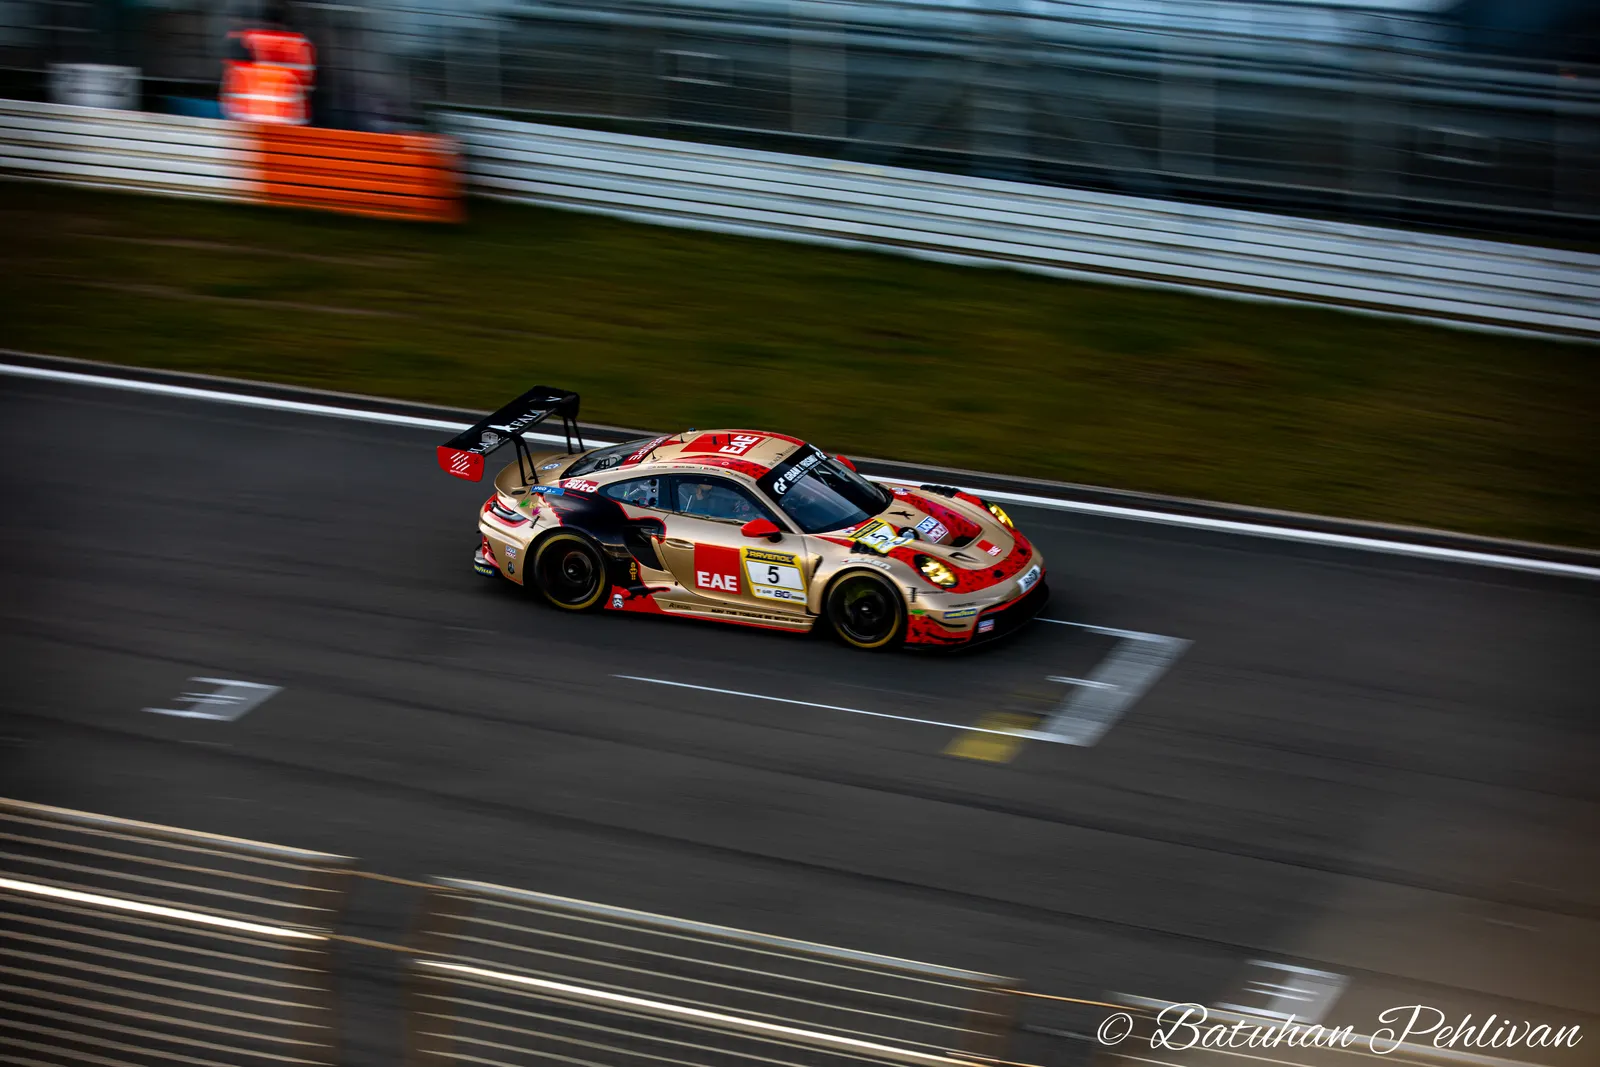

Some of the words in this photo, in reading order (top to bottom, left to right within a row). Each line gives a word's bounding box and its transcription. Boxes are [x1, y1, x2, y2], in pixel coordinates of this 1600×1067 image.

[718, 435, 760, 455] EAE
[564, 481, 598, 493] auto
[697, 571, 738, 591] EAE
[767, 566, 780, 584] 5
[739, 612, 763, 620] TORQUE
